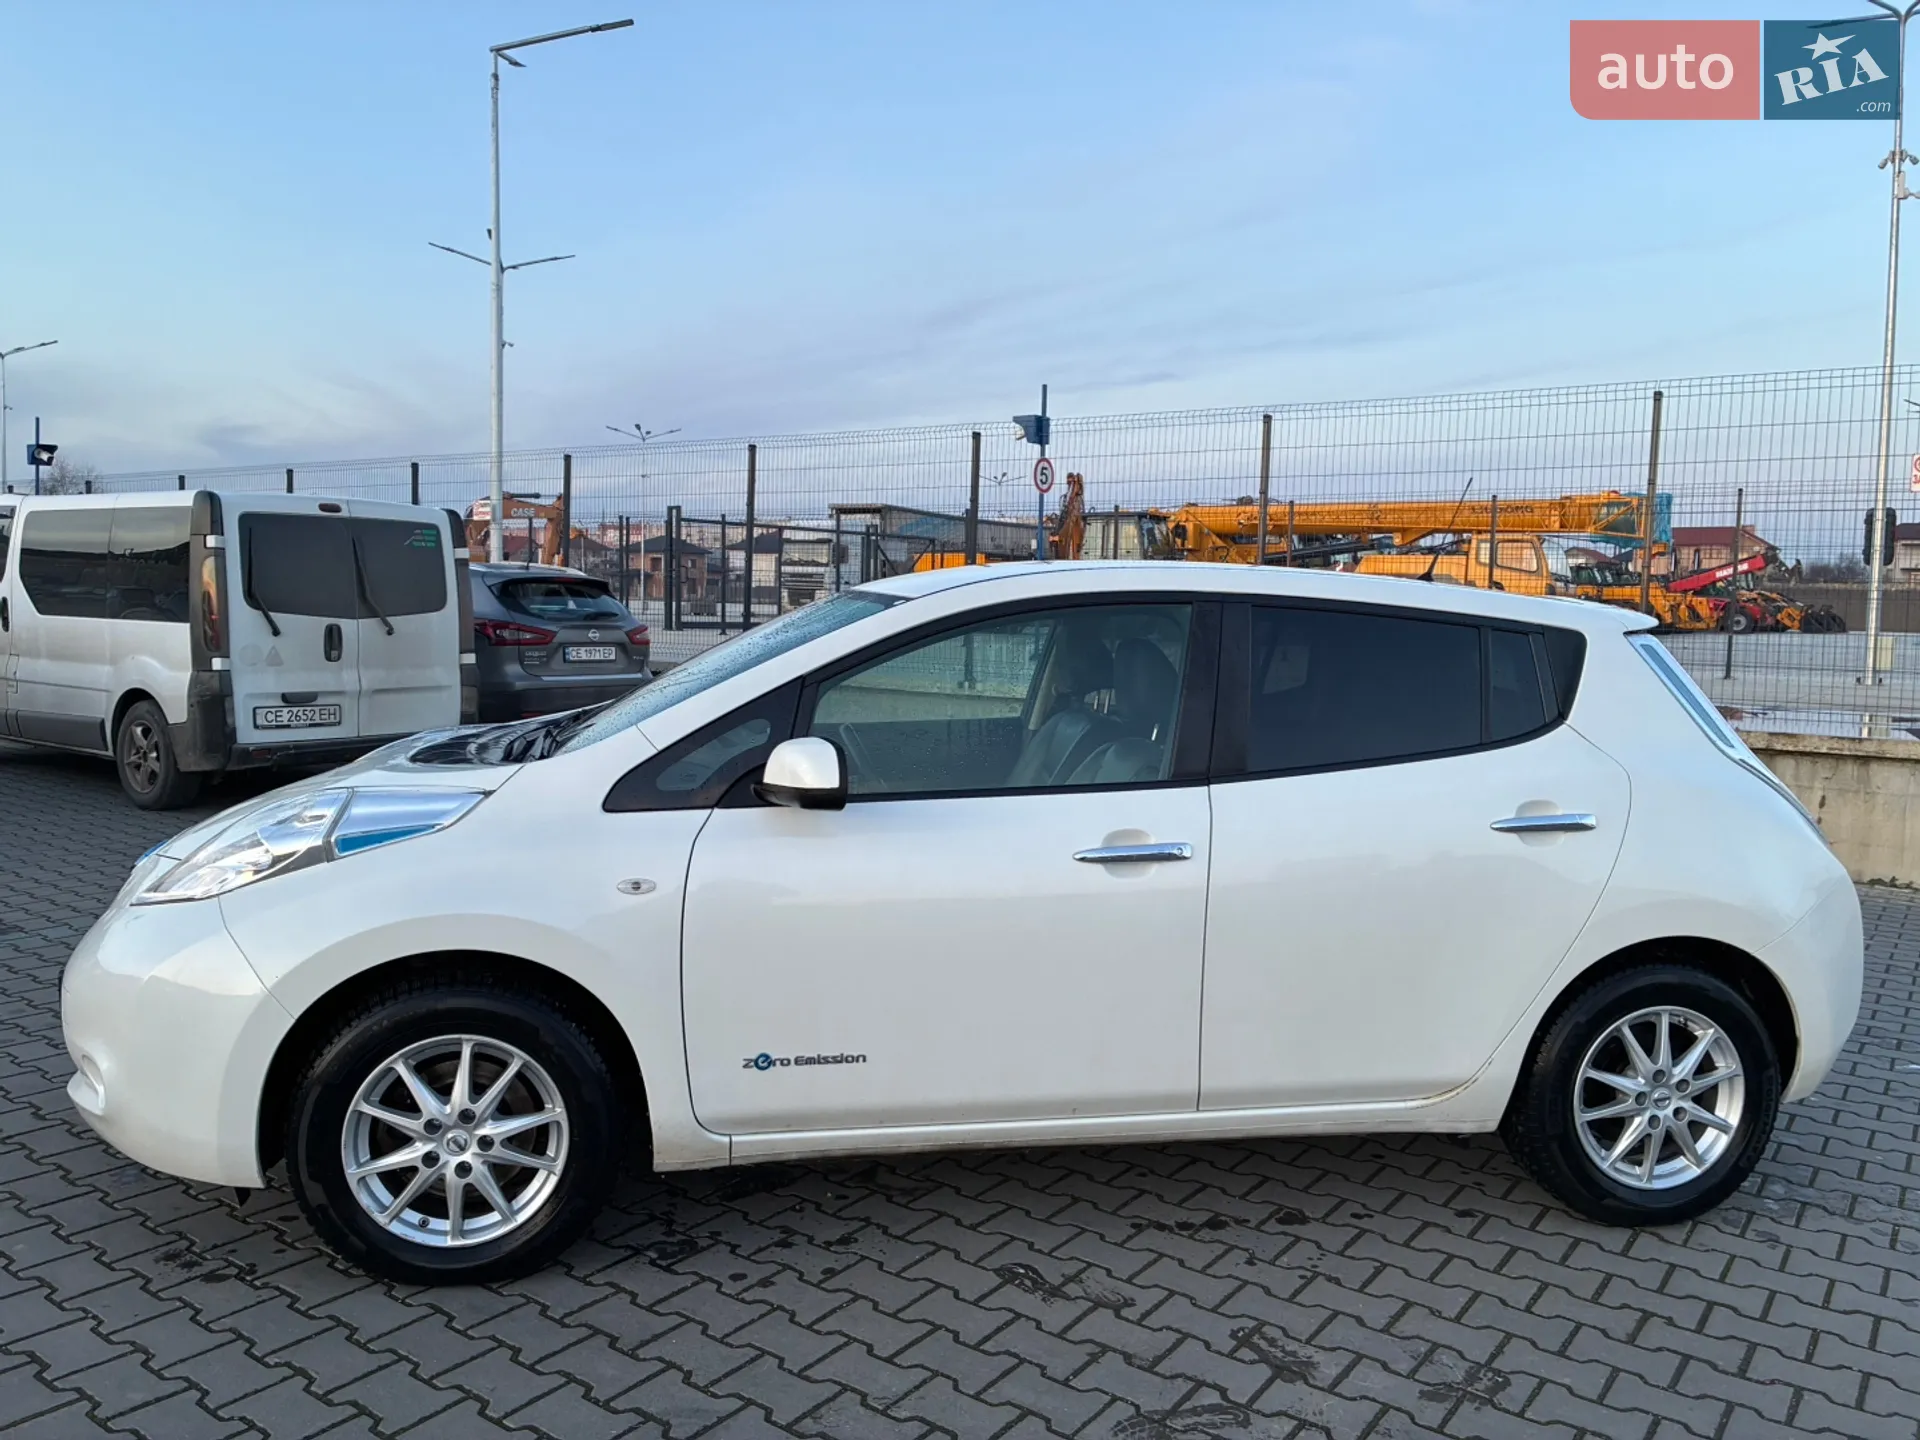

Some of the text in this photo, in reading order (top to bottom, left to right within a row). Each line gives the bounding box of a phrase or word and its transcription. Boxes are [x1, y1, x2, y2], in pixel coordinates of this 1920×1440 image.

[1039, 466, 1048, 485] 5
[511, 507, 536, 517] CASE
[584, 647, 602, 659] 1971
[264, 707, 337, 723] CE 2652 EH
